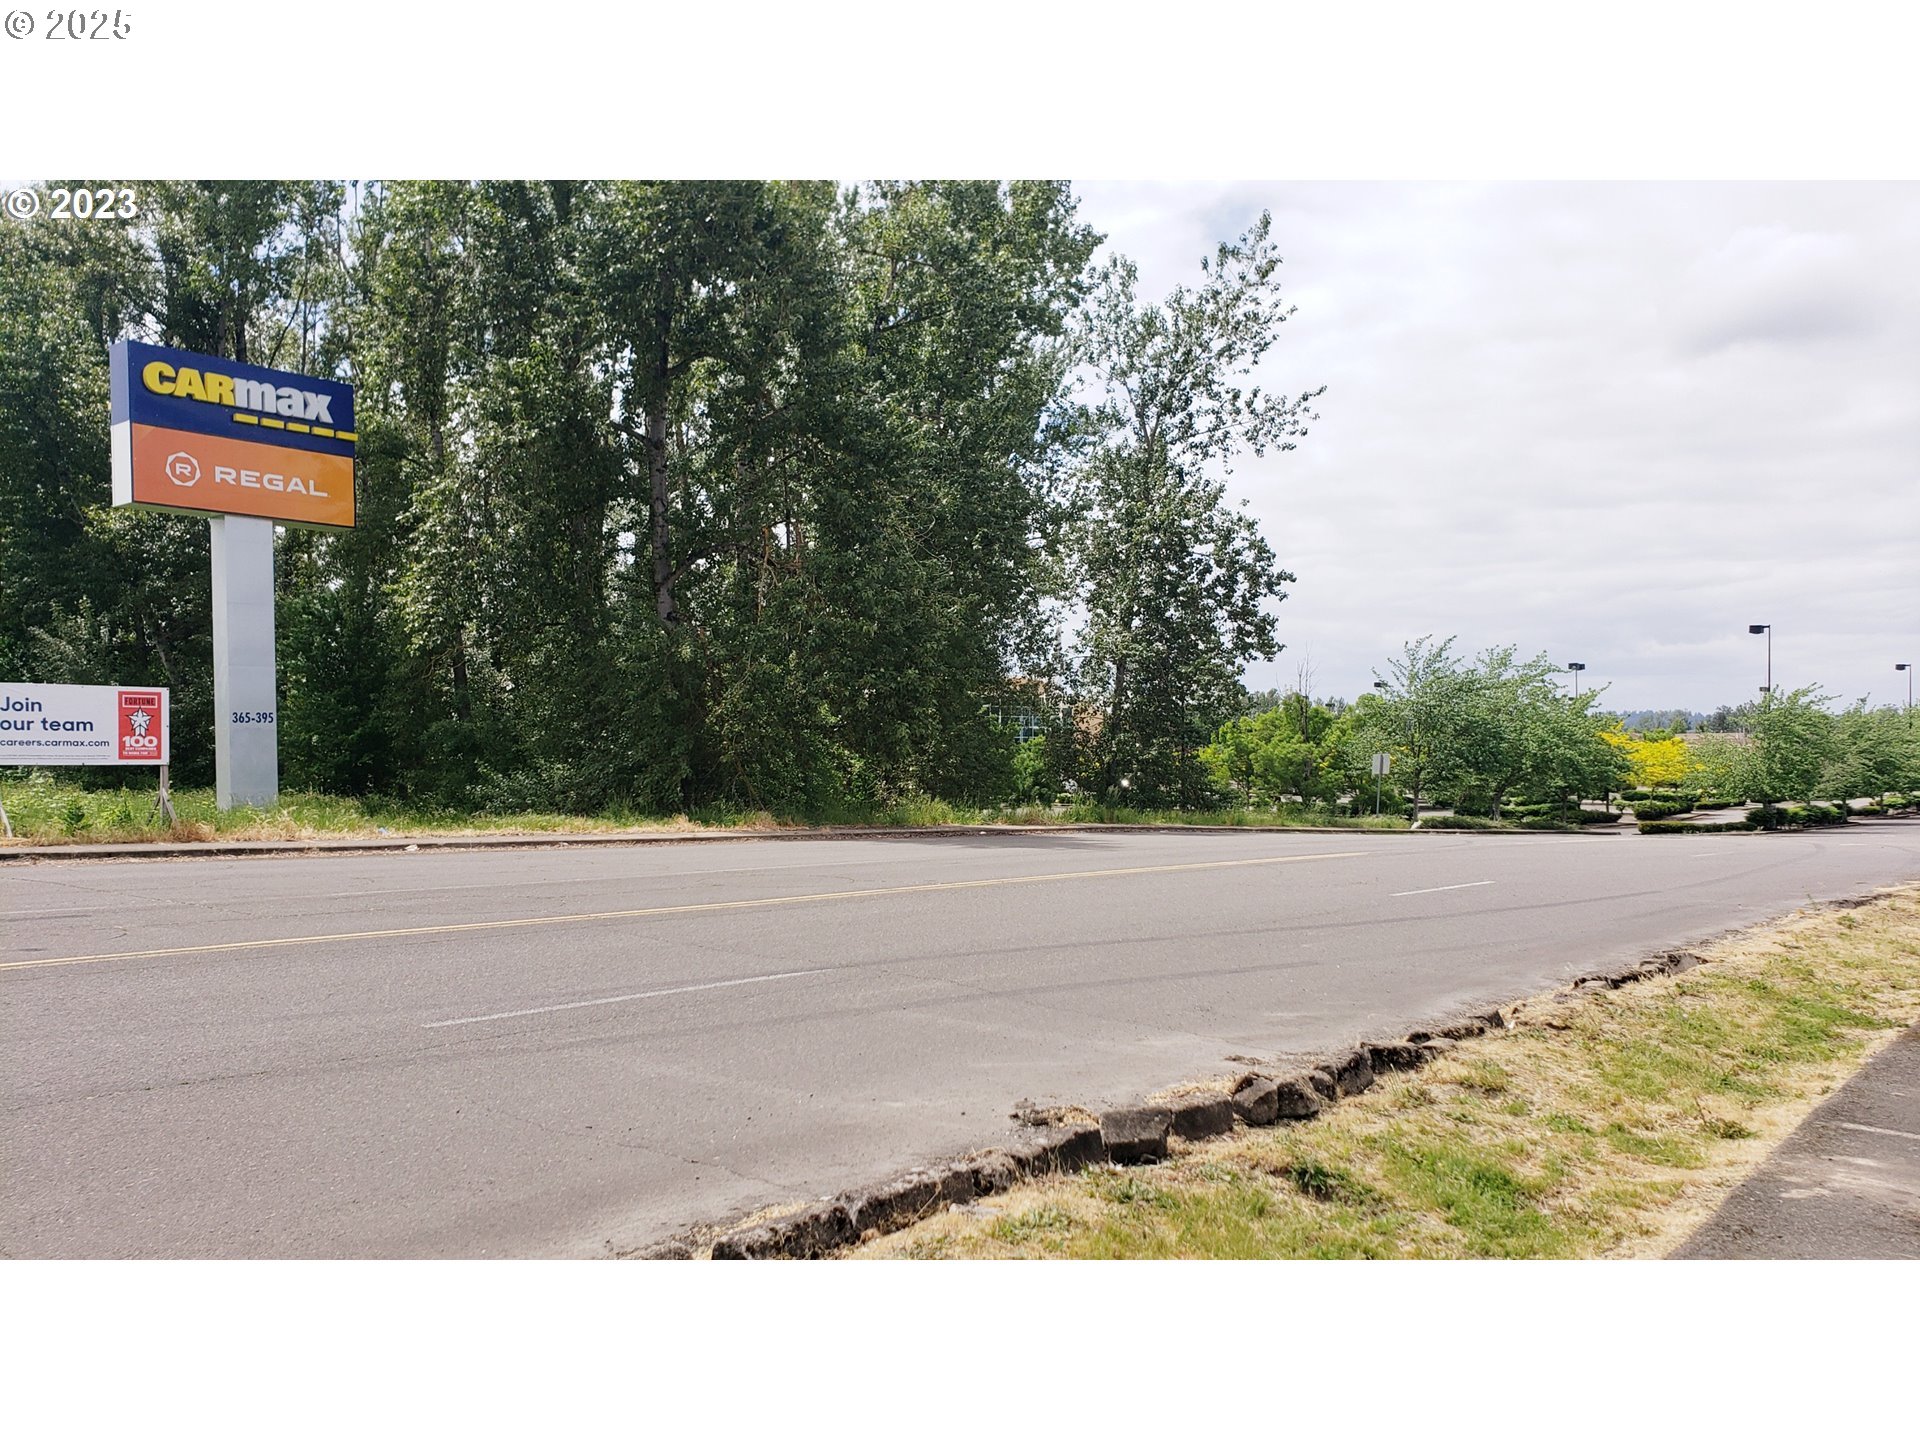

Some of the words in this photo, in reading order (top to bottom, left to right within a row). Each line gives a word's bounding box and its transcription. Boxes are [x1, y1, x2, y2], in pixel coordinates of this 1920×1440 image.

[142, 361, 334, 424] CARmax
[214, 465, 328, 497] REGAL
[0, 696, 42, 712] Join
[124, 697, 157, 706] FORTUNE
[0, 719, 34, 731] our
[41, 717, 94, 732] team
[232, 711, 274, 724] 365-395
[0, 739, 110, 747] careers.carmax.com
[122, 735, 158, 748] 100
